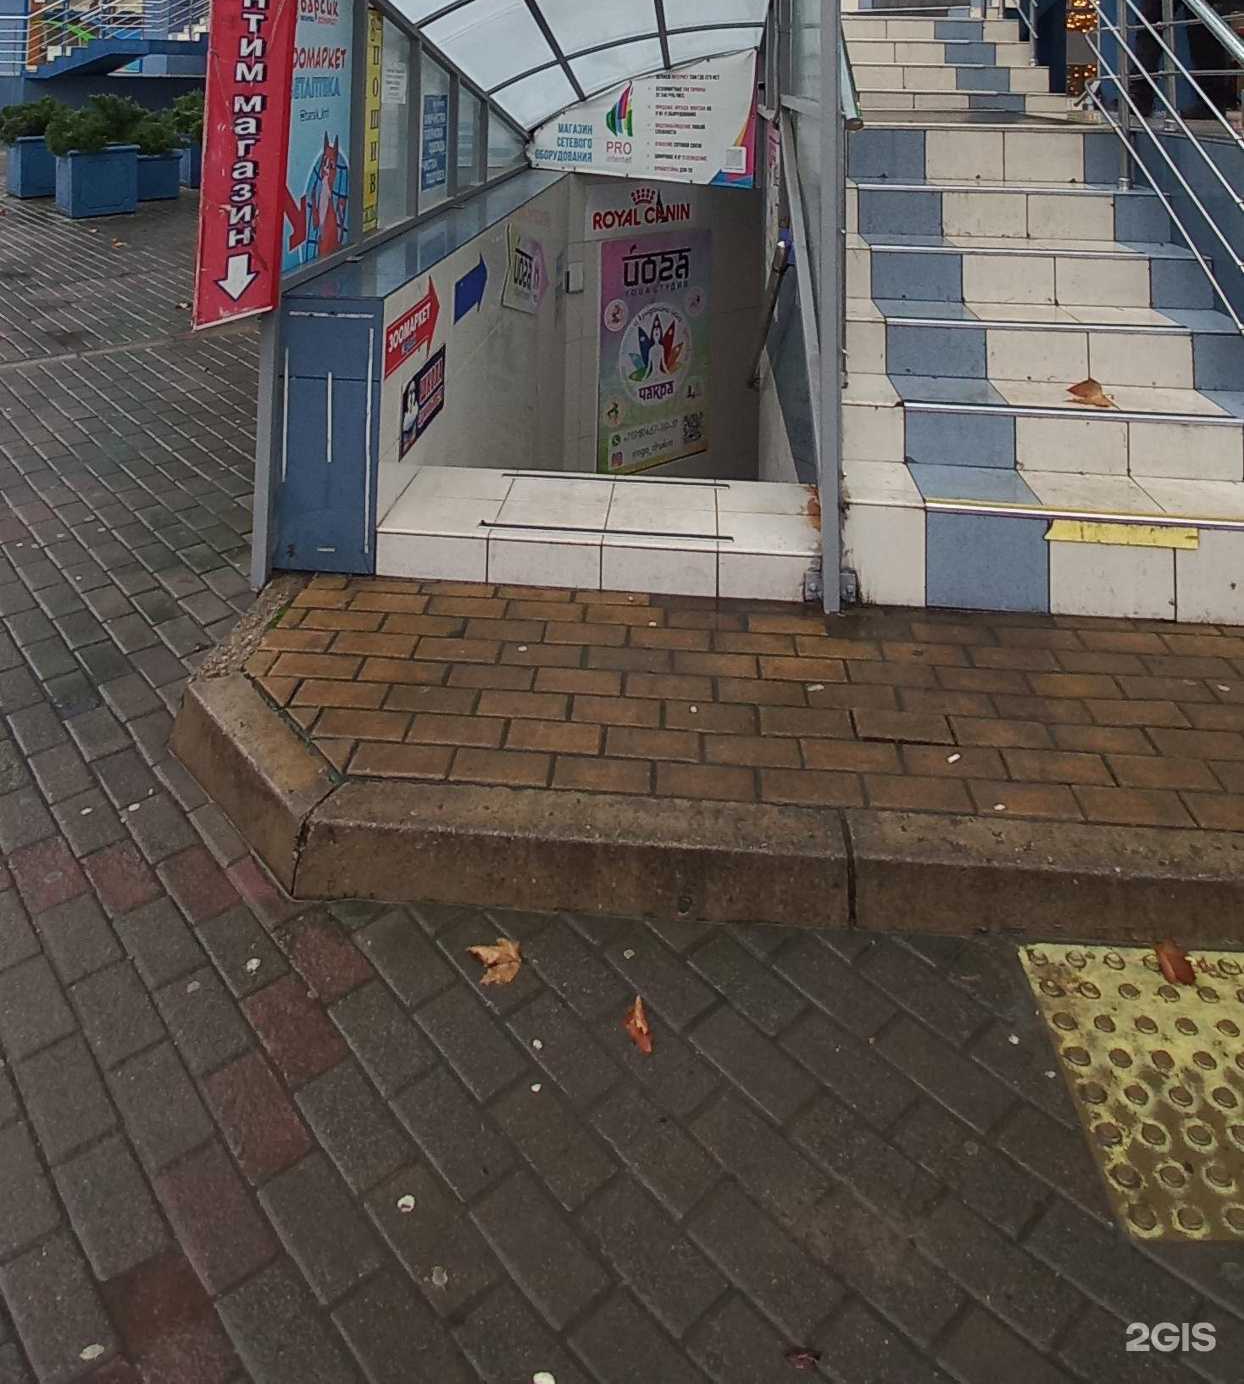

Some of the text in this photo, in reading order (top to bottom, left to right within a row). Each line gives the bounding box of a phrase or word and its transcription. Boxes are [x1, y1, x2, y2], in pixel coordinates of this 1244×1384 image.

[558, 123, 592, 135] МАГАЗИН
[557, 137, 592, 149] СЕТЕВОГО
[606, 141, 632, 155] PRO
[593, 203, 690, 231] ROYAL CANIN
[388, 303, 432, 353] ЗООМАРКЕТ
